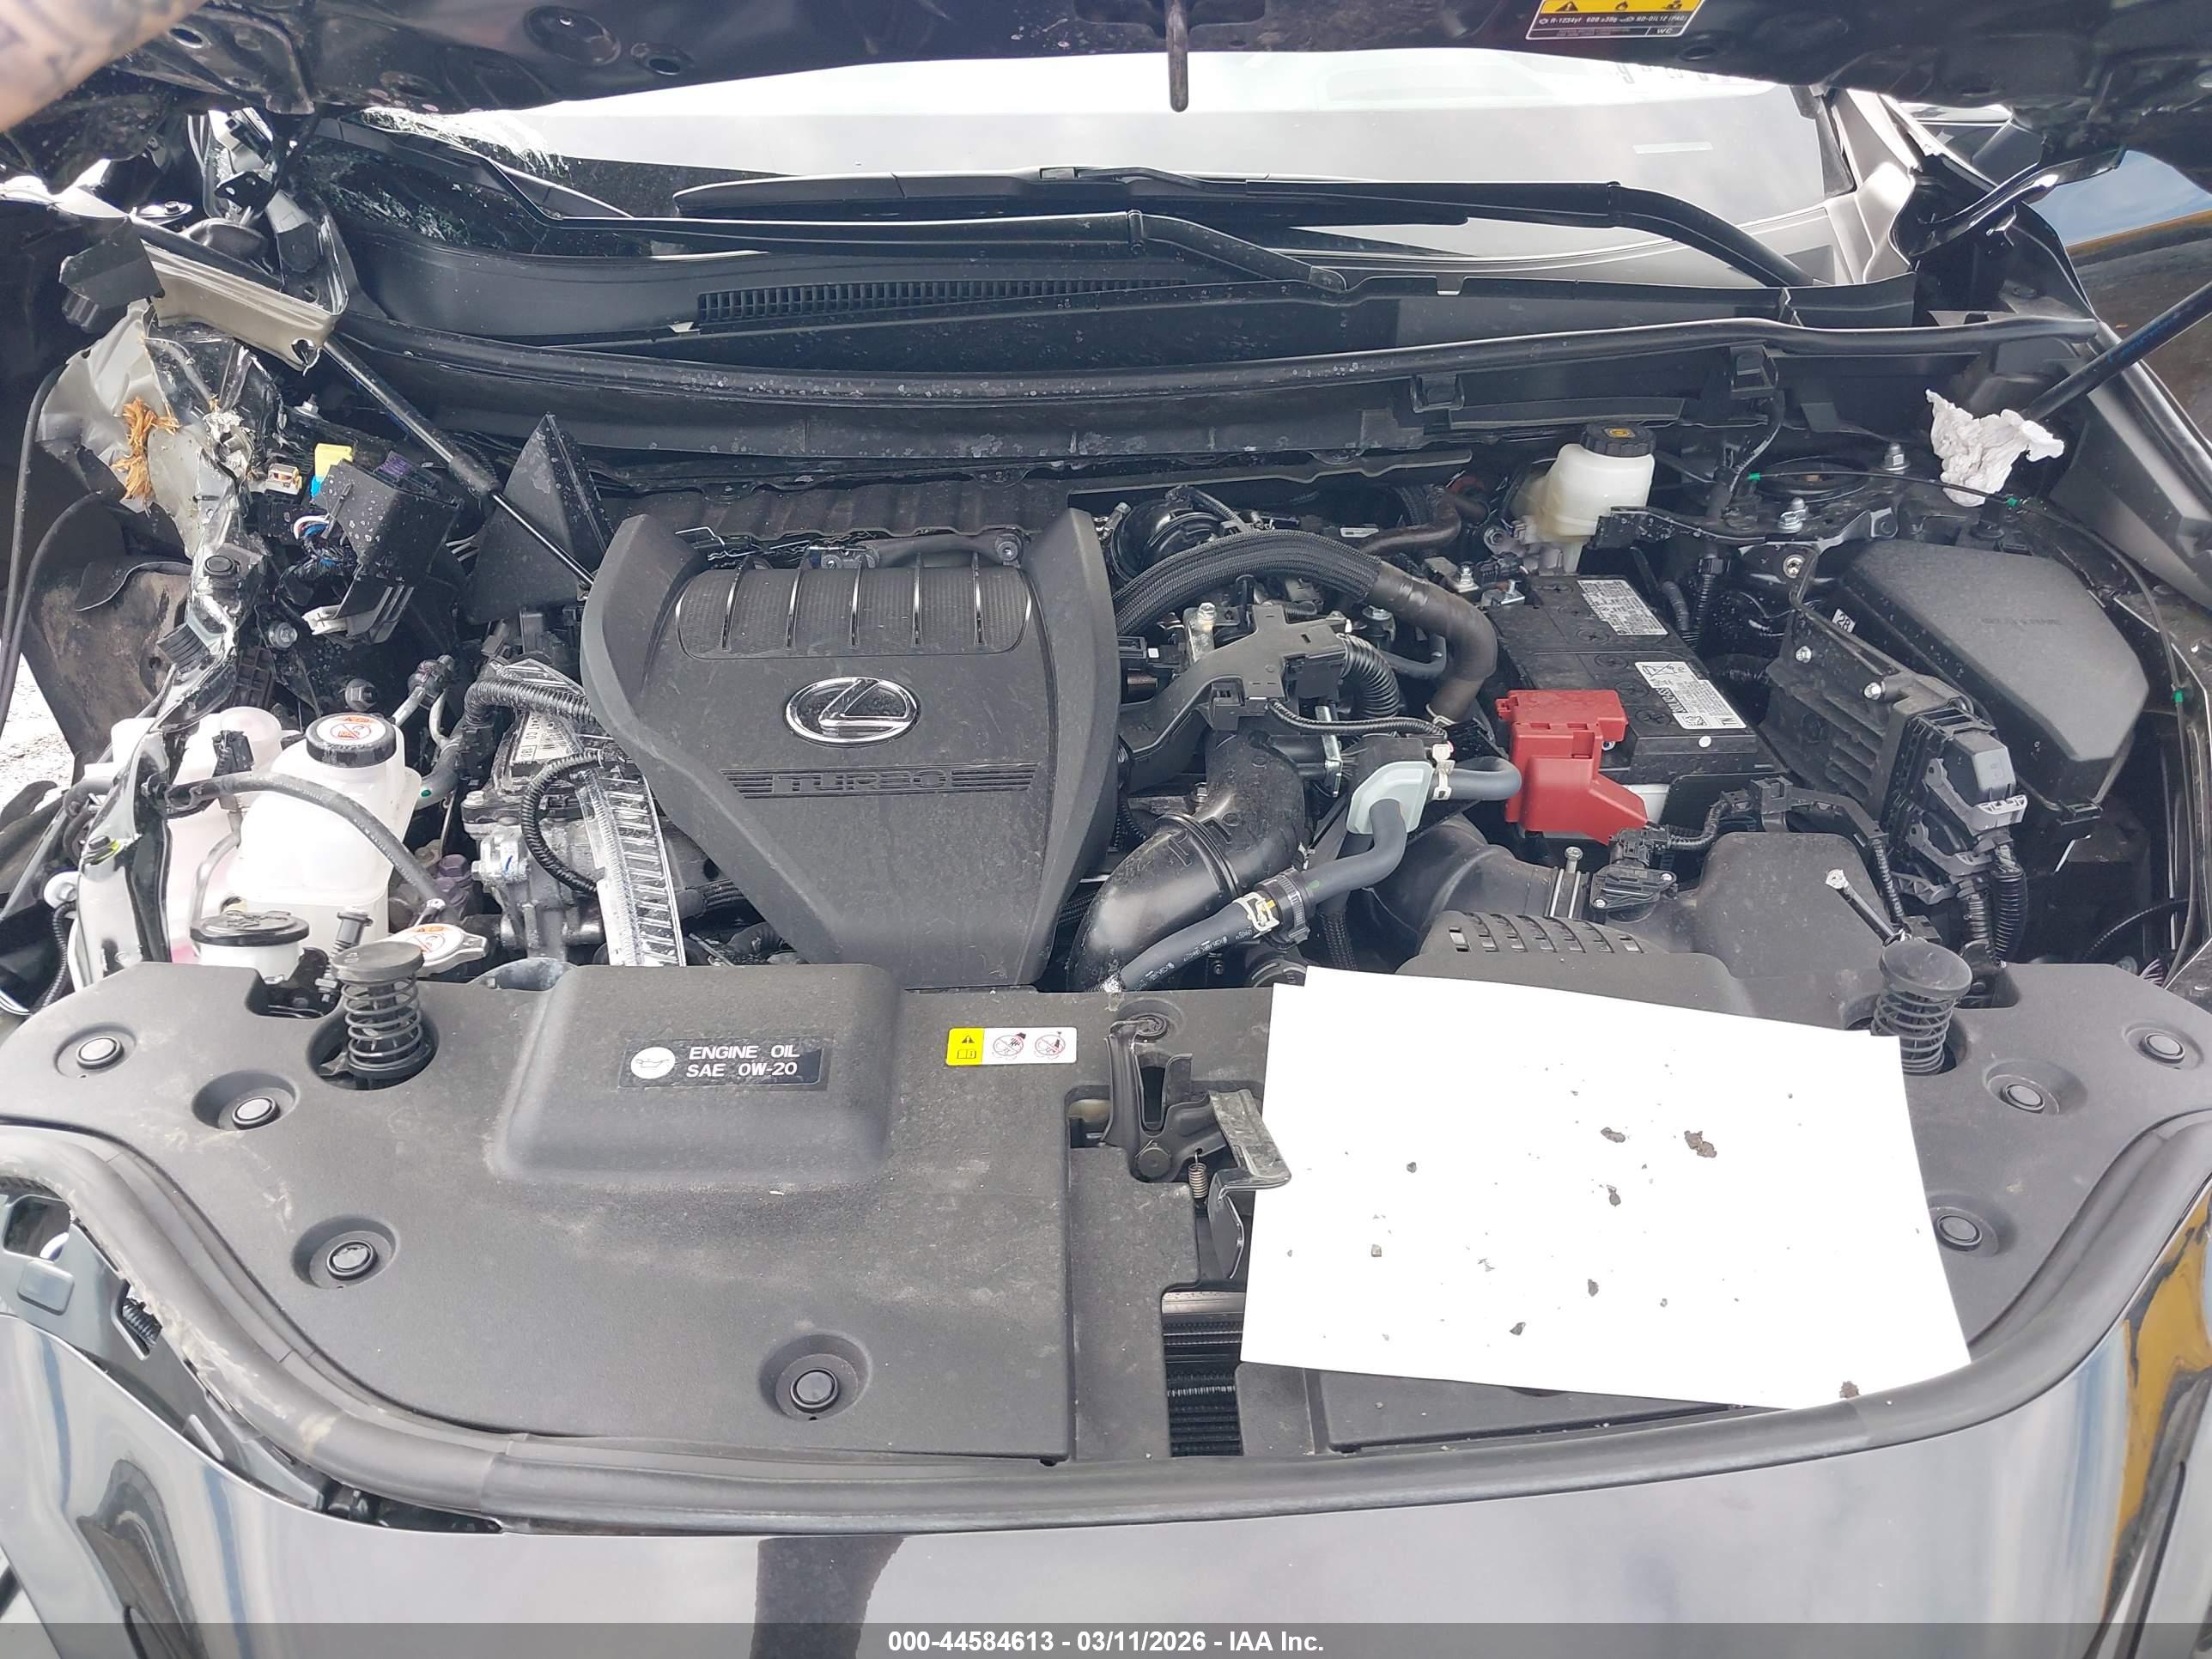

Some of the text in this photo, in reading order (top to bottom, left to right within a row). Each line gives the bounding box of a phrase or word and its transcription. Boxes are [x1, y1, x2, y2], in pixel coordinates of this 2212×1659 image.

[1837, 613, 1850, 632] 28
[777, 770, 948, 793] TURBO
[689, 1044, 800, 1060] ENGINE OIL
[686, 1061, 798, 1078] SAE 0W-20
